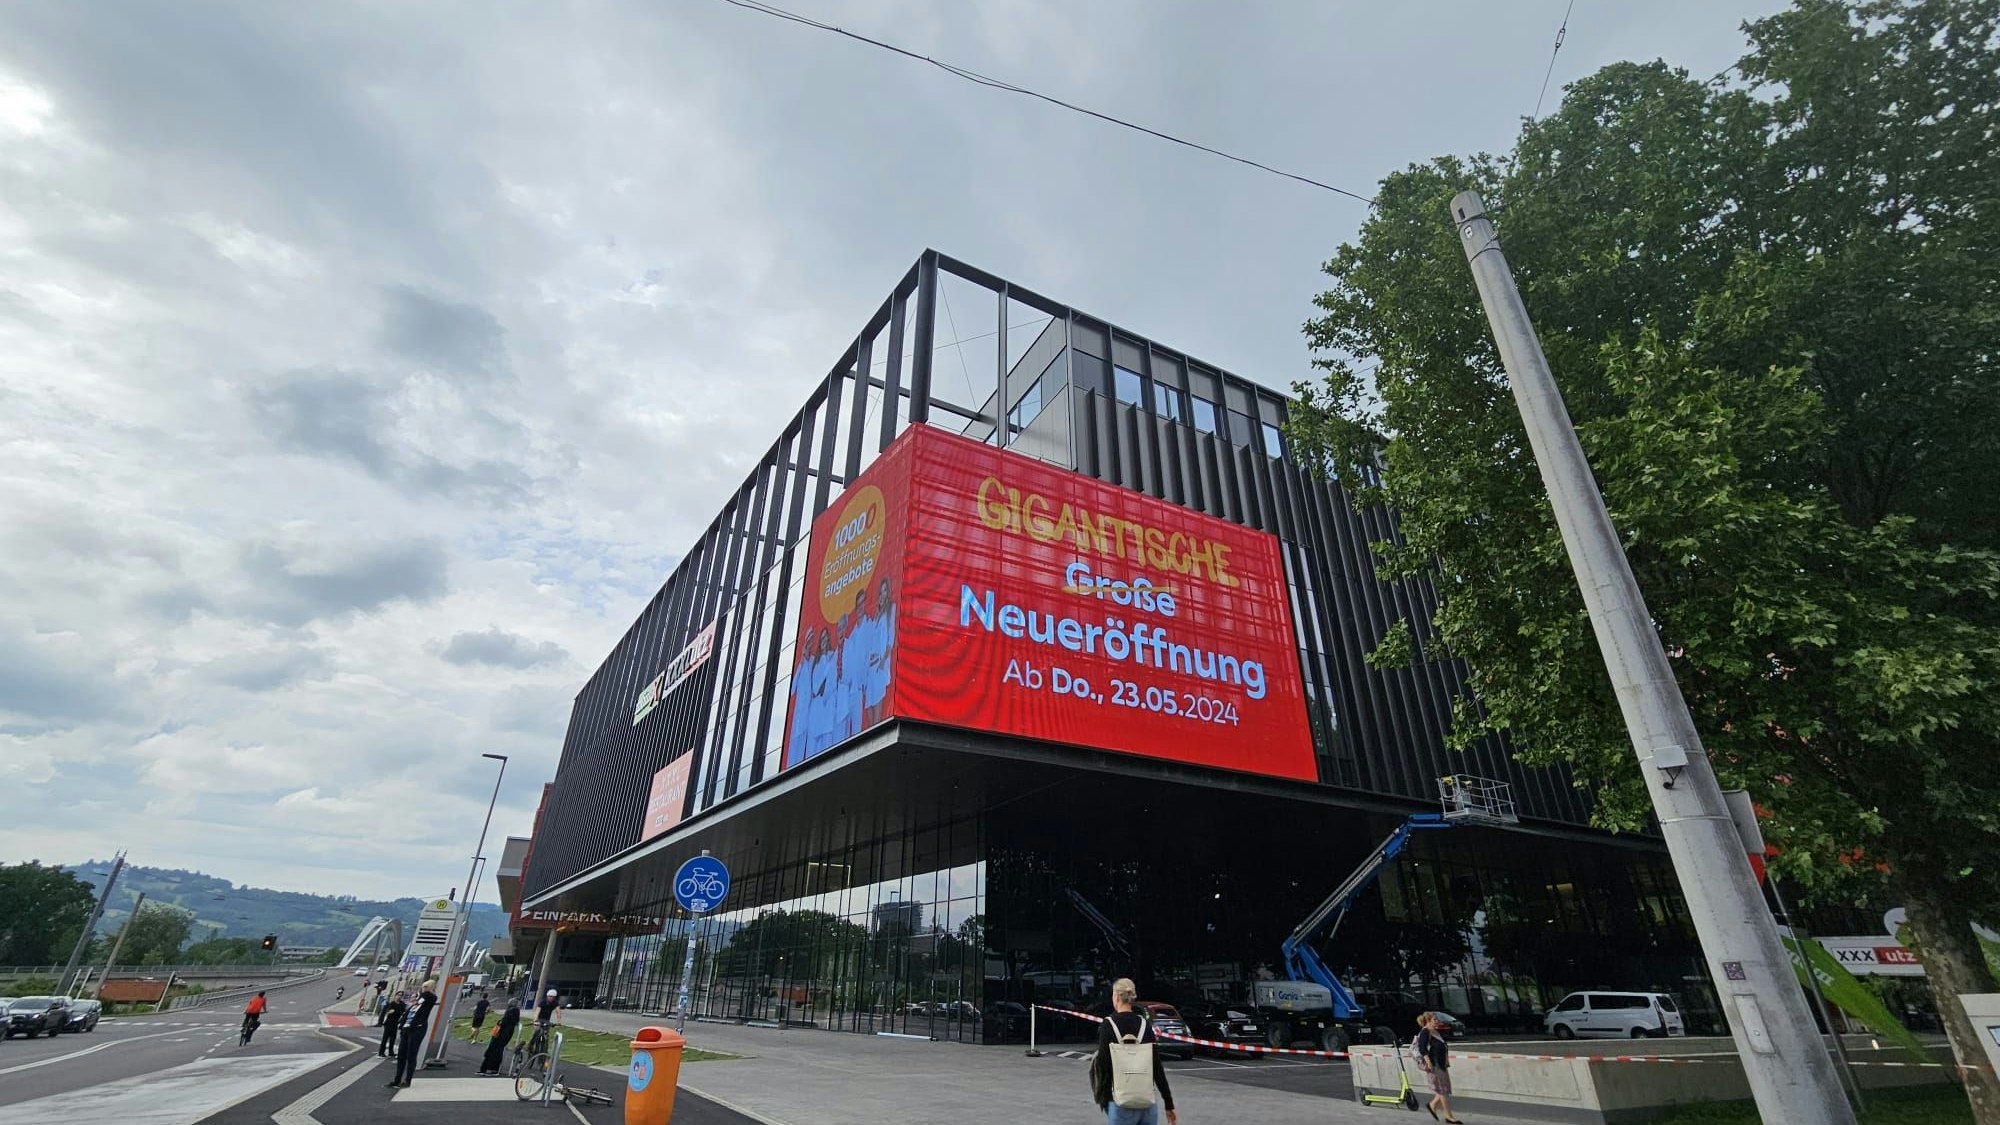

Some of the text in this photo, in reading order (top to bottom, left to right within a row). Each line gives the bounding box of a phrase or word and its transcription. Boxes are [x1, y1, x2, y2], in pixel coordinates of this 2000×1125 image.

[824, 533, 881, 579] Eröffnungs-
[977, 476, 1240, 588] GIGANTISCHE
[824, 558, 873, 598] angebote
[1066, 562, 1176, 617] Große
[959, 583, 1267, 699] Neueröffnung
[1002, 658, 1240, 727] Ab Do., 23.05.2024
[532, 910, 606, 924] EINFAHR
